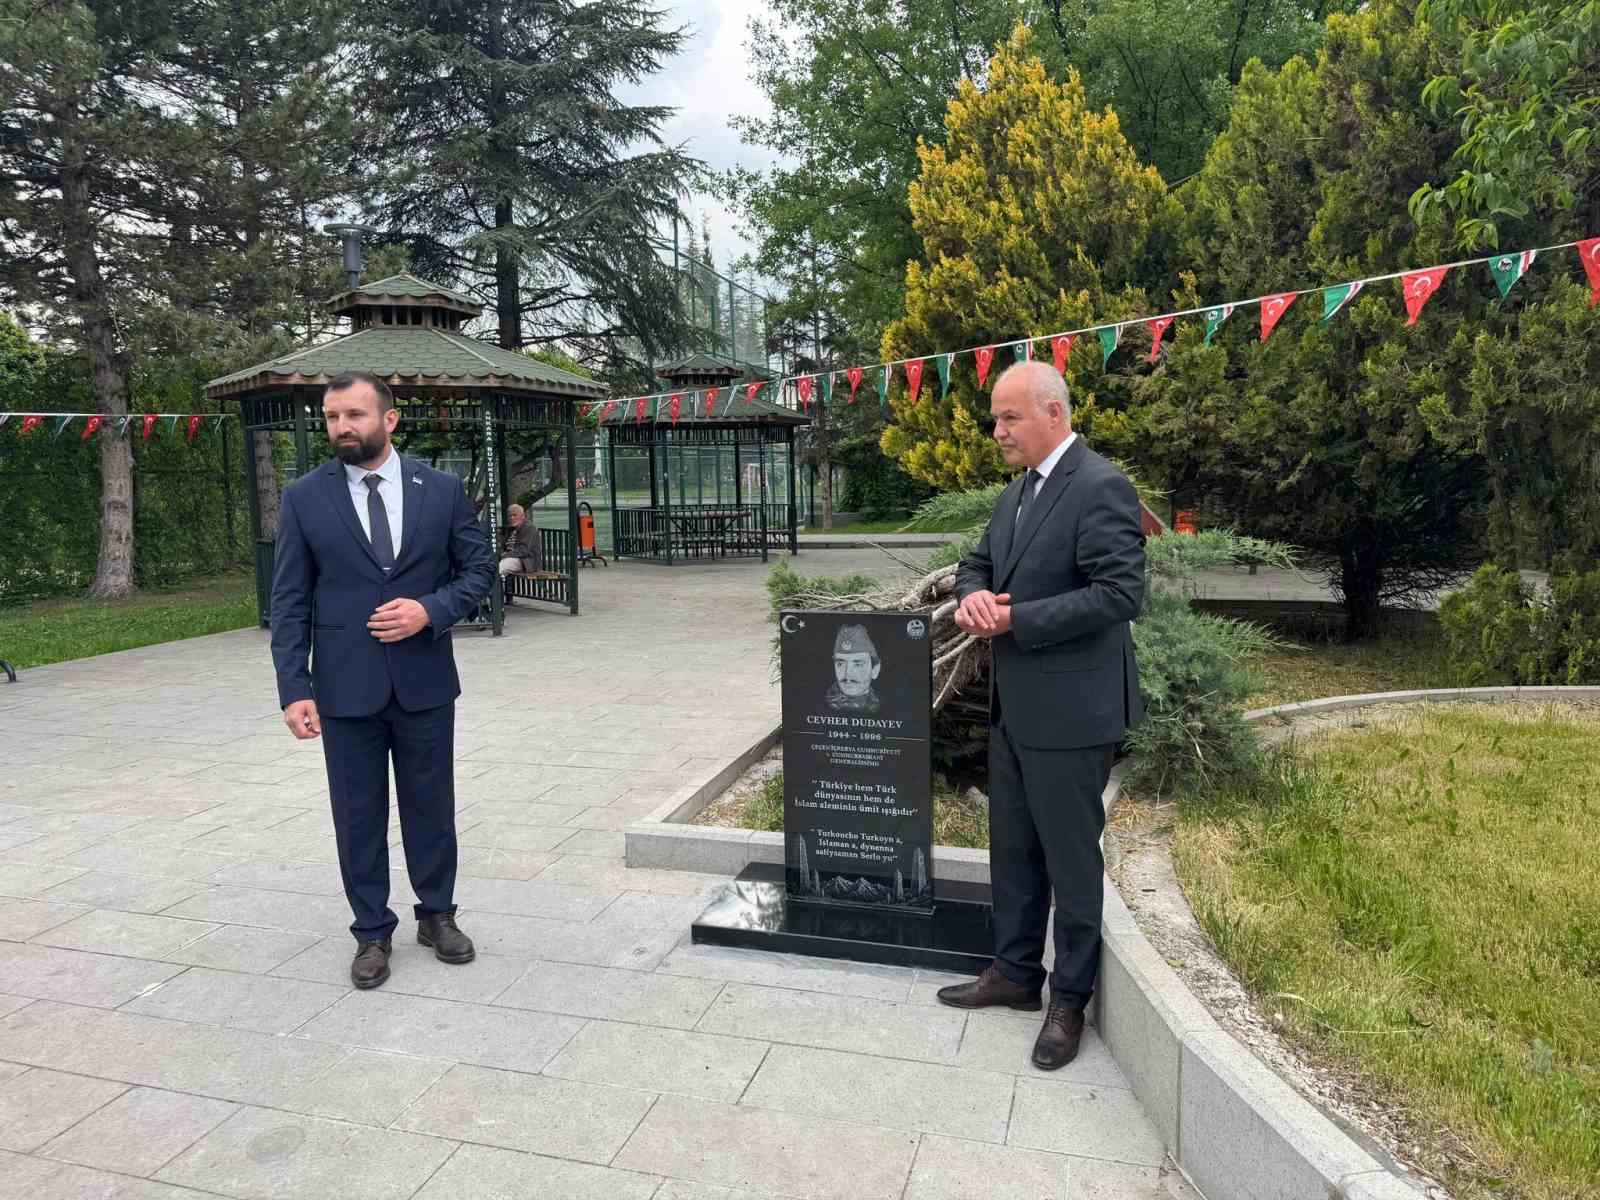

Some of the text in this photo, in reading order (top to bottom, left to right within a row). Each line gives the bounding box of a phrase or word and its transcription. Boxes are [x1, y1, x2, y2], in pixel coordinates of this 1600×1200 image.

[807, 715, 904, 729] CEVHER DUDAYEV
[828, 730, 850, 739] 1944
[876, 784, 896, 793] Türk
[863, 794, 882, 803] hem
[884, 796, 896, 804] de
